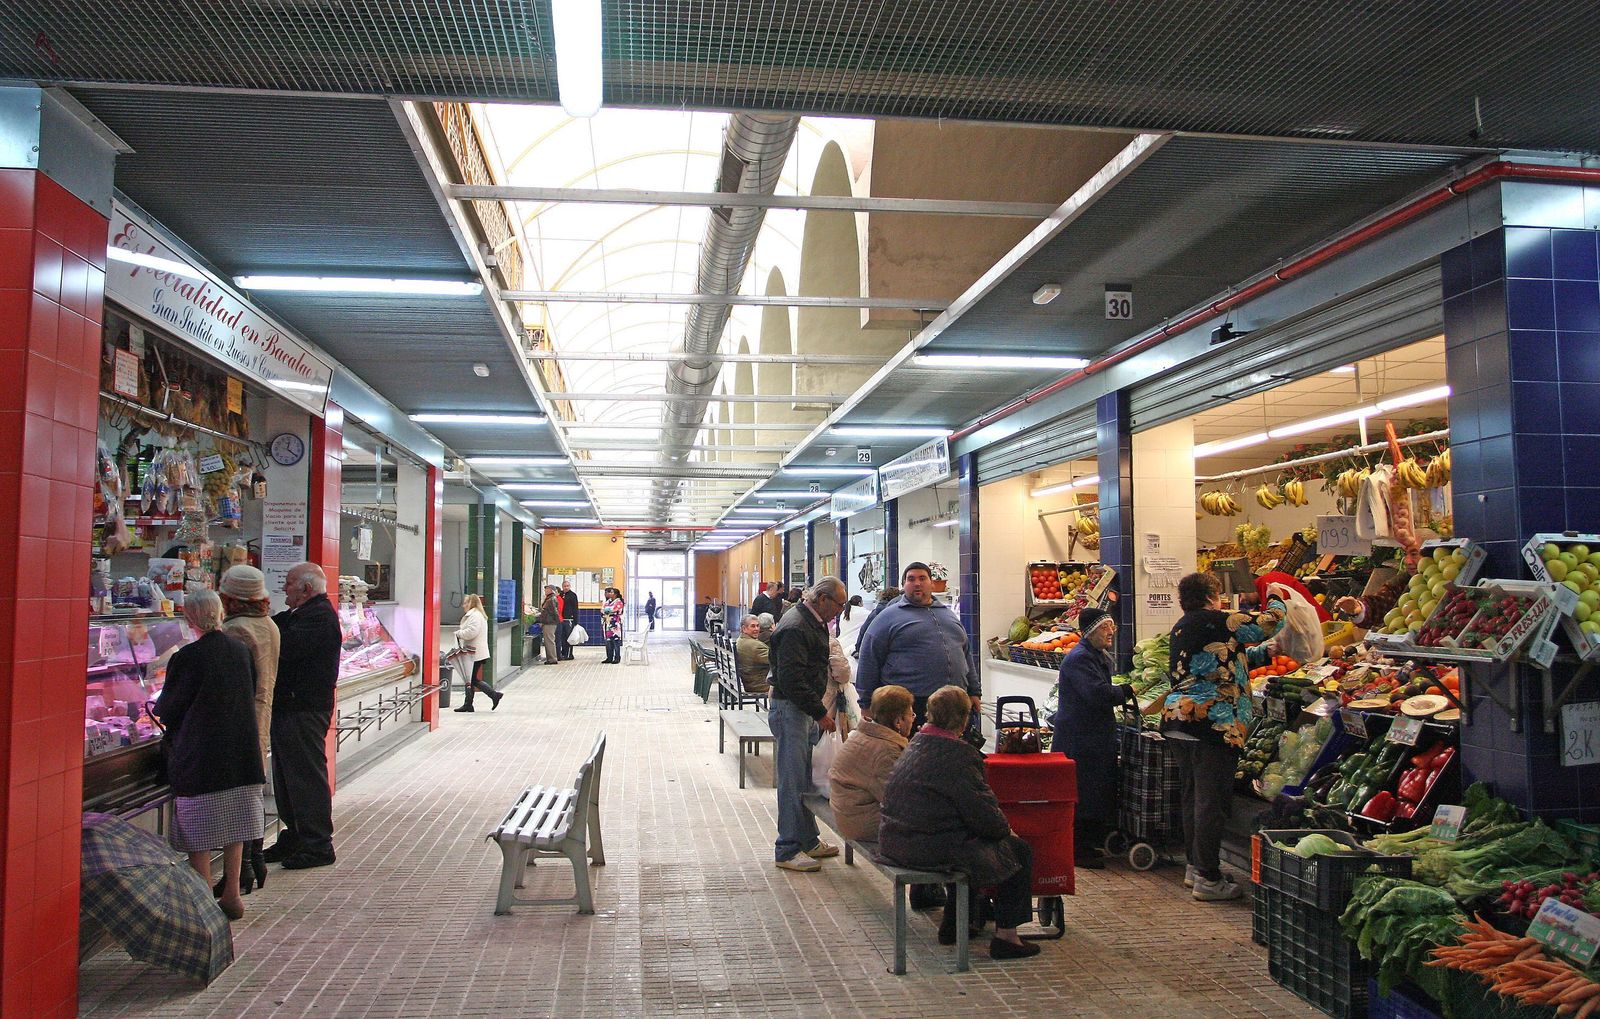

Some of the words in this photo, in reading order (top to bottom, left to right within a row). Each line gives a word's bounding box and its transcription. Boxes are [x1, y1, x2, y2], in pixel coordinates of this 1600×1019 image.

[1109, 298, 1131, 318] 30
[152, 287, 179, 325] Gran
[179, 305, 213, 345] Surtido
[213, 337, 226, 352] en
[241, 325, 259, 344] en
[261, 328, 313, 379] Bacalao
[858, 452, 870, 462] 29
[810, 485, 819, 493] 28
[1148, 593, 1172, 601] PORTES
[1511, 595, 1551, 642] FRES-LUZ
